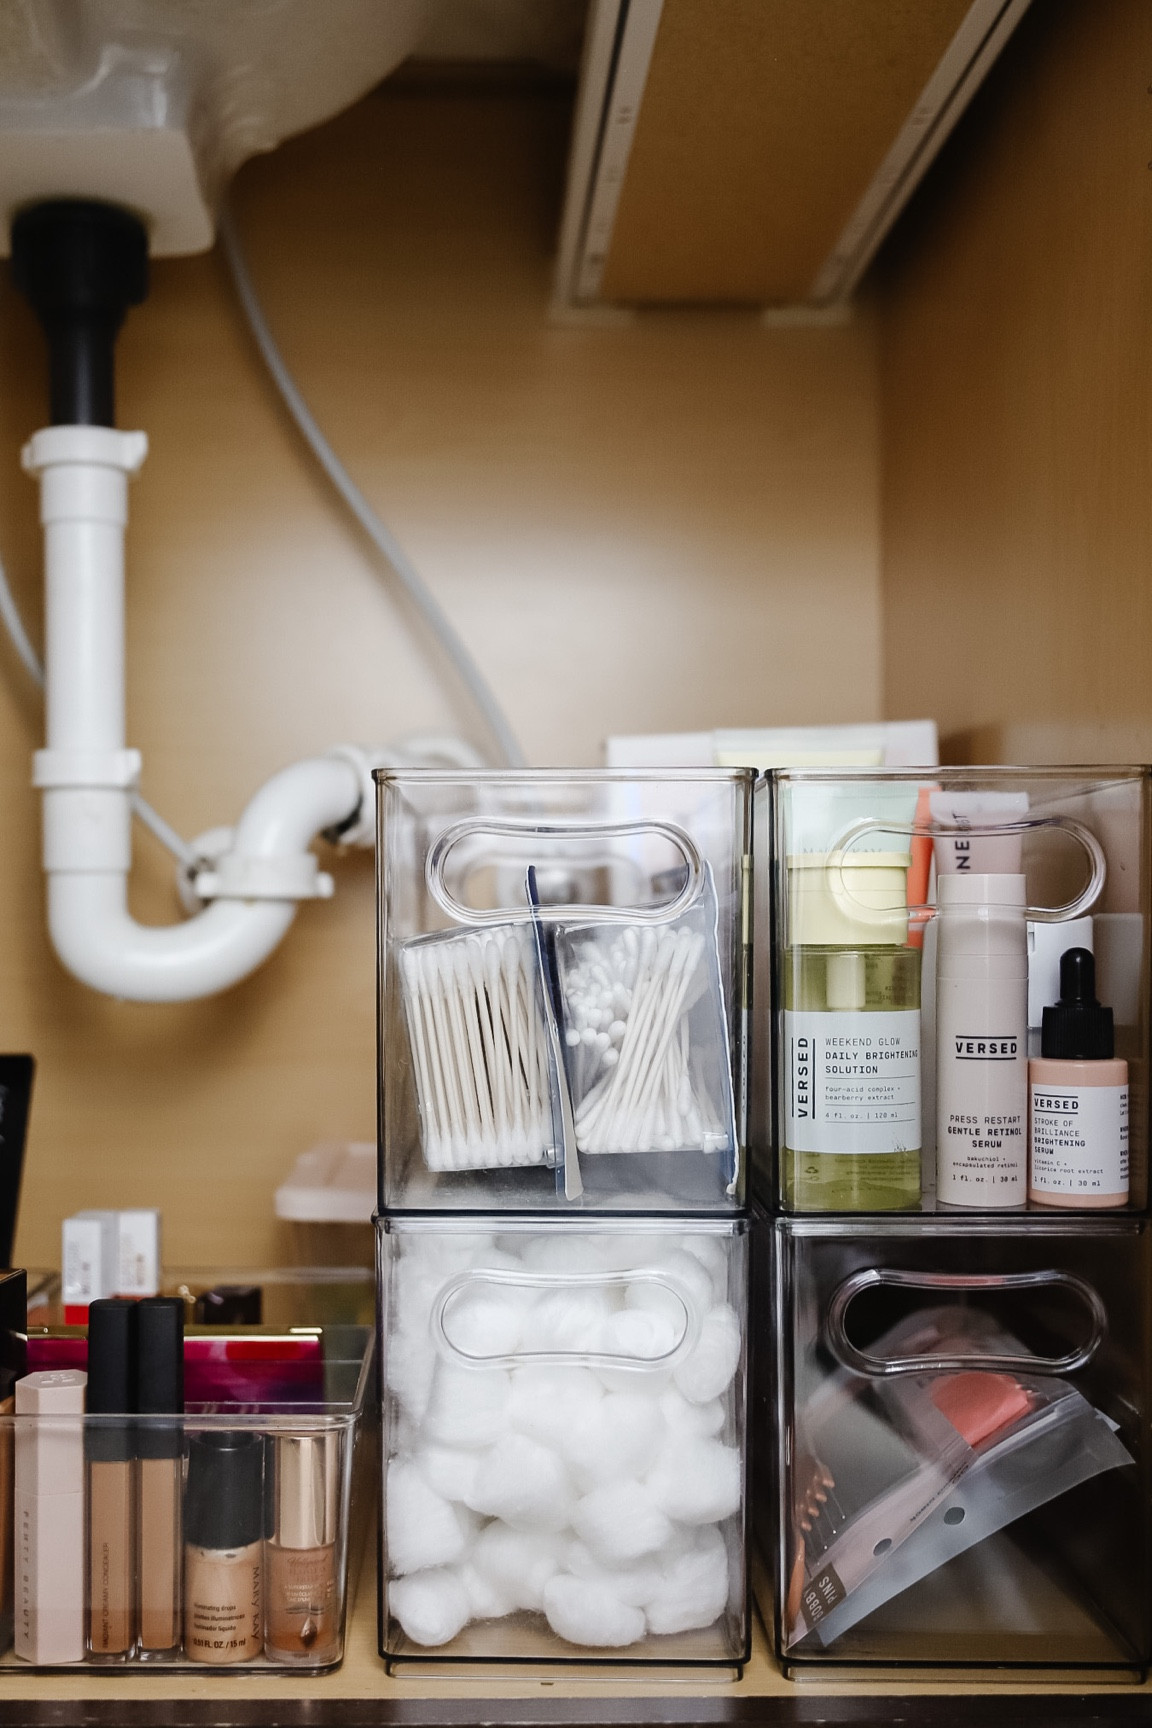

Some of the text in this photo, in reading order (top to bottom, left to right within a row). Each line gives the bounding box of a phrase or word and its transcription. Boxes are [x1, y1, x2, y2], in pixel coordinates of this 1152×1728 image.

[825, 1037, 900, 1046] WEEKEND GLOW
[956, 1042, 1017, 1054] VERSED
[825, 1049, 918, 1060] DAILY BRIGHTENING
[825, 1066, 878, 1074] SOLUTION
[798, 1038, 808, 1118] VERSED
[868, 1086, 894, 1094] complex
[1034, 1098, 1079, 1110] VERSED
[950, 1115, 1021, 1124] PRESS RESTART
[1034, 1118, 1058, 1126] STROKE
[948, 1126, 1022, 1136] GENTLE RETINOL
[1034, 1127, 1079, 1137] BRILLIANCE
[972, 1140, 1002, 1148] SERUM
[1034, 1137, 1086, 1147] BRIGHTENING
[1034, 1146, 1054, 1155] SERUM
[818, 1576, 838, 1605] PINS
[252, 1566, 260, 1640] MARY KAY
[230, 1639, 238, 1647] 15
[239, 1637, 246, 1646] ml
